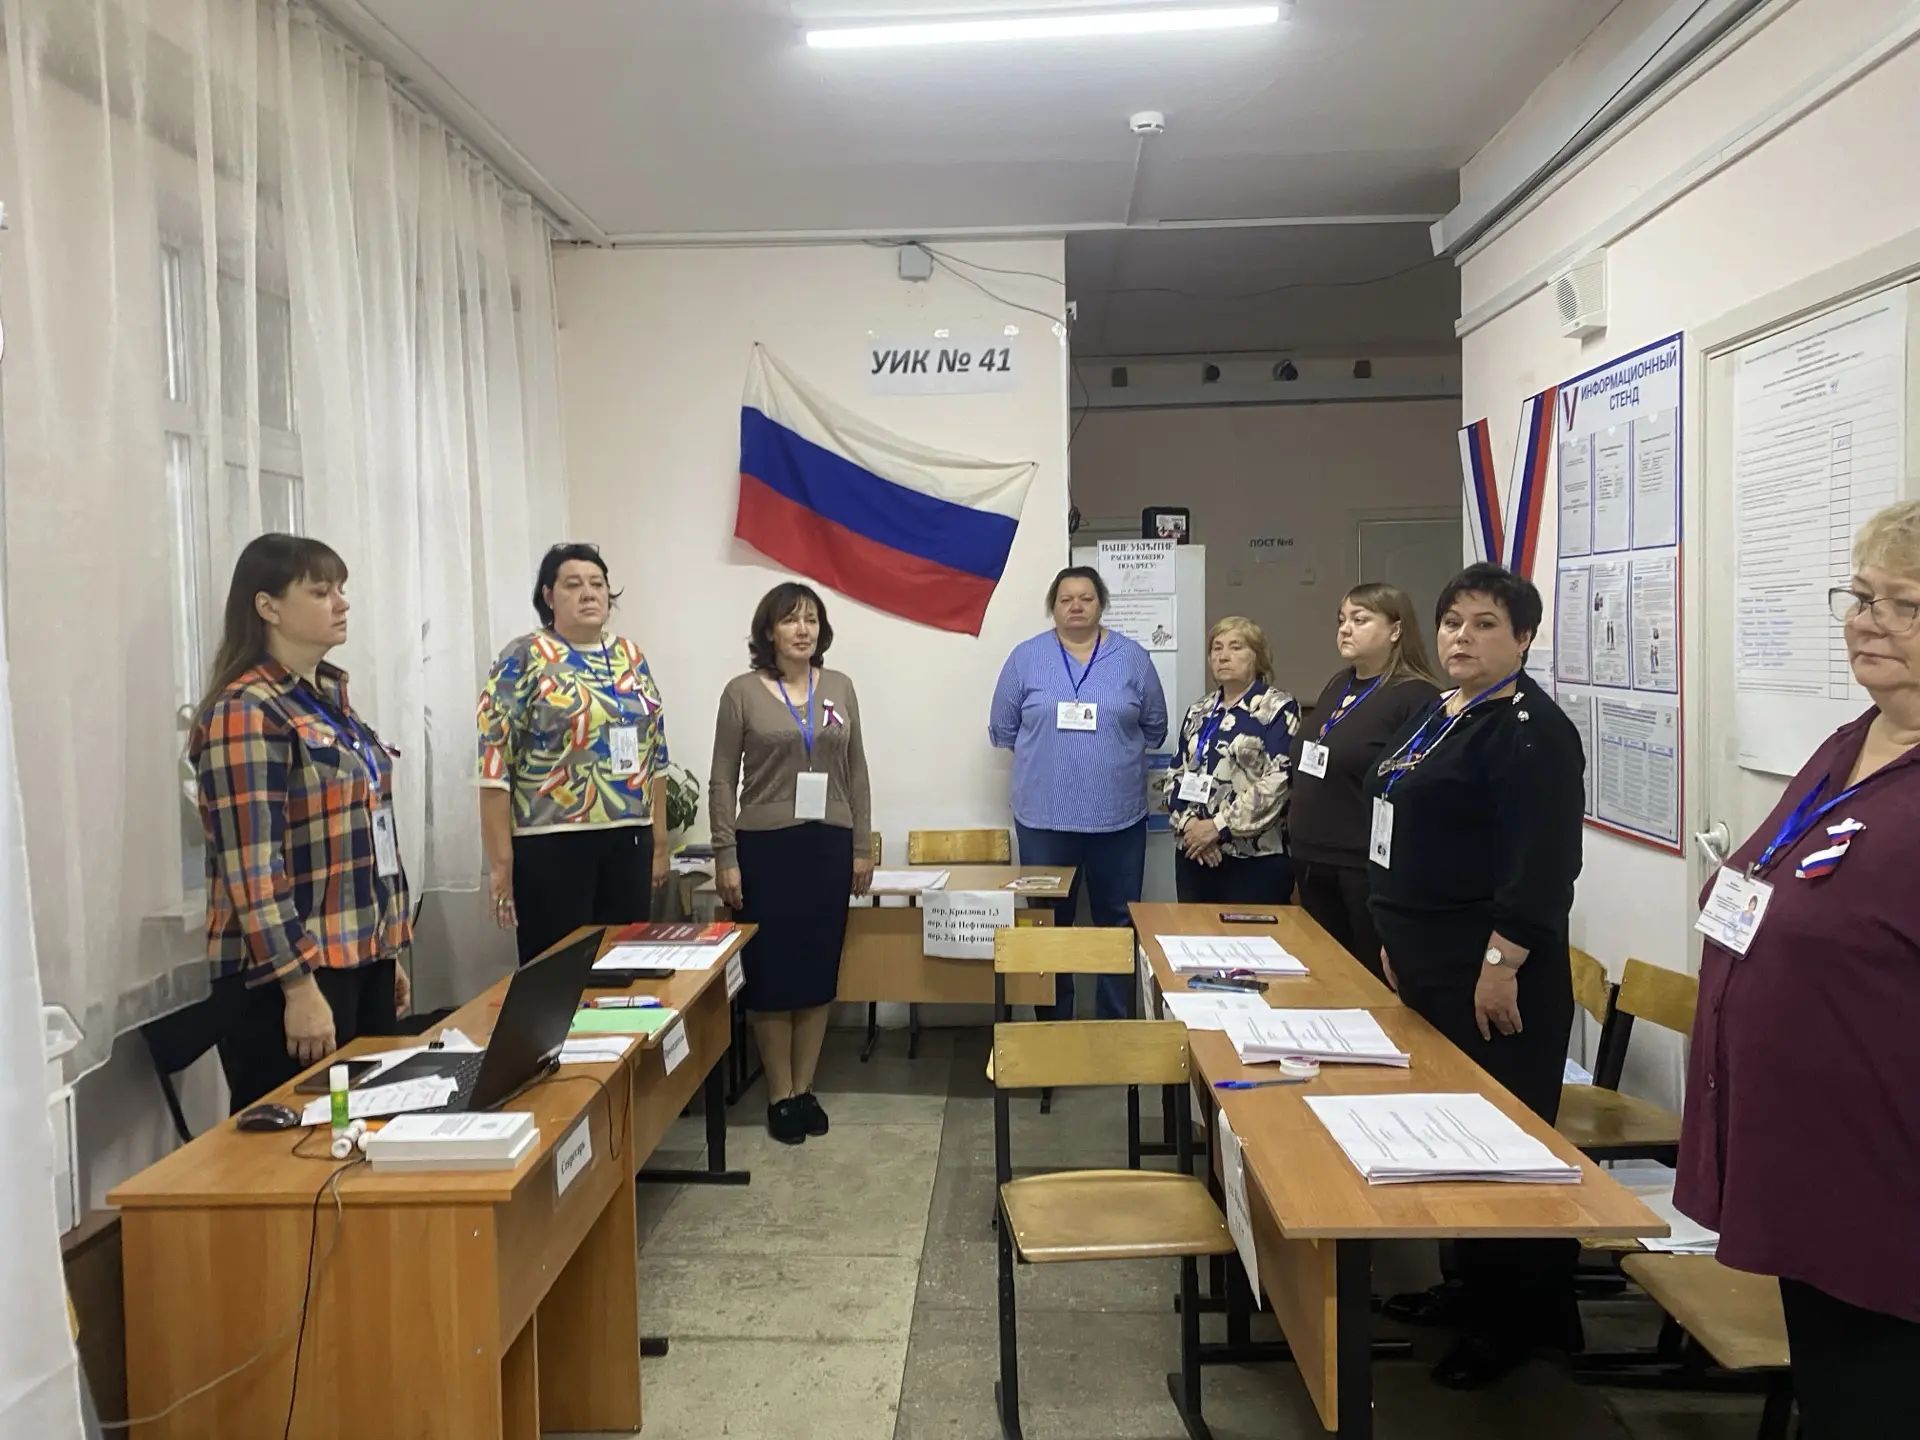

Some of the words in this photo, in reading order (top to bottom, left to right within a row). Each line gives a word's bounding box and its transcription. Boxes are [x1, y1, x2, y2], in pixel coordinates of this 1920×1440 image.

[871, 350, 930, 375] УИК
[937, 349, 971, 373] №
[979, 348, 1011, 372] 41
[1581, 346, 1677, 401] ИНФОРМАЦИОННЫЙ
[1609, 386, 1640, 411] СТЕНД
[1250, 538, 1275, 548] ПОСТ
